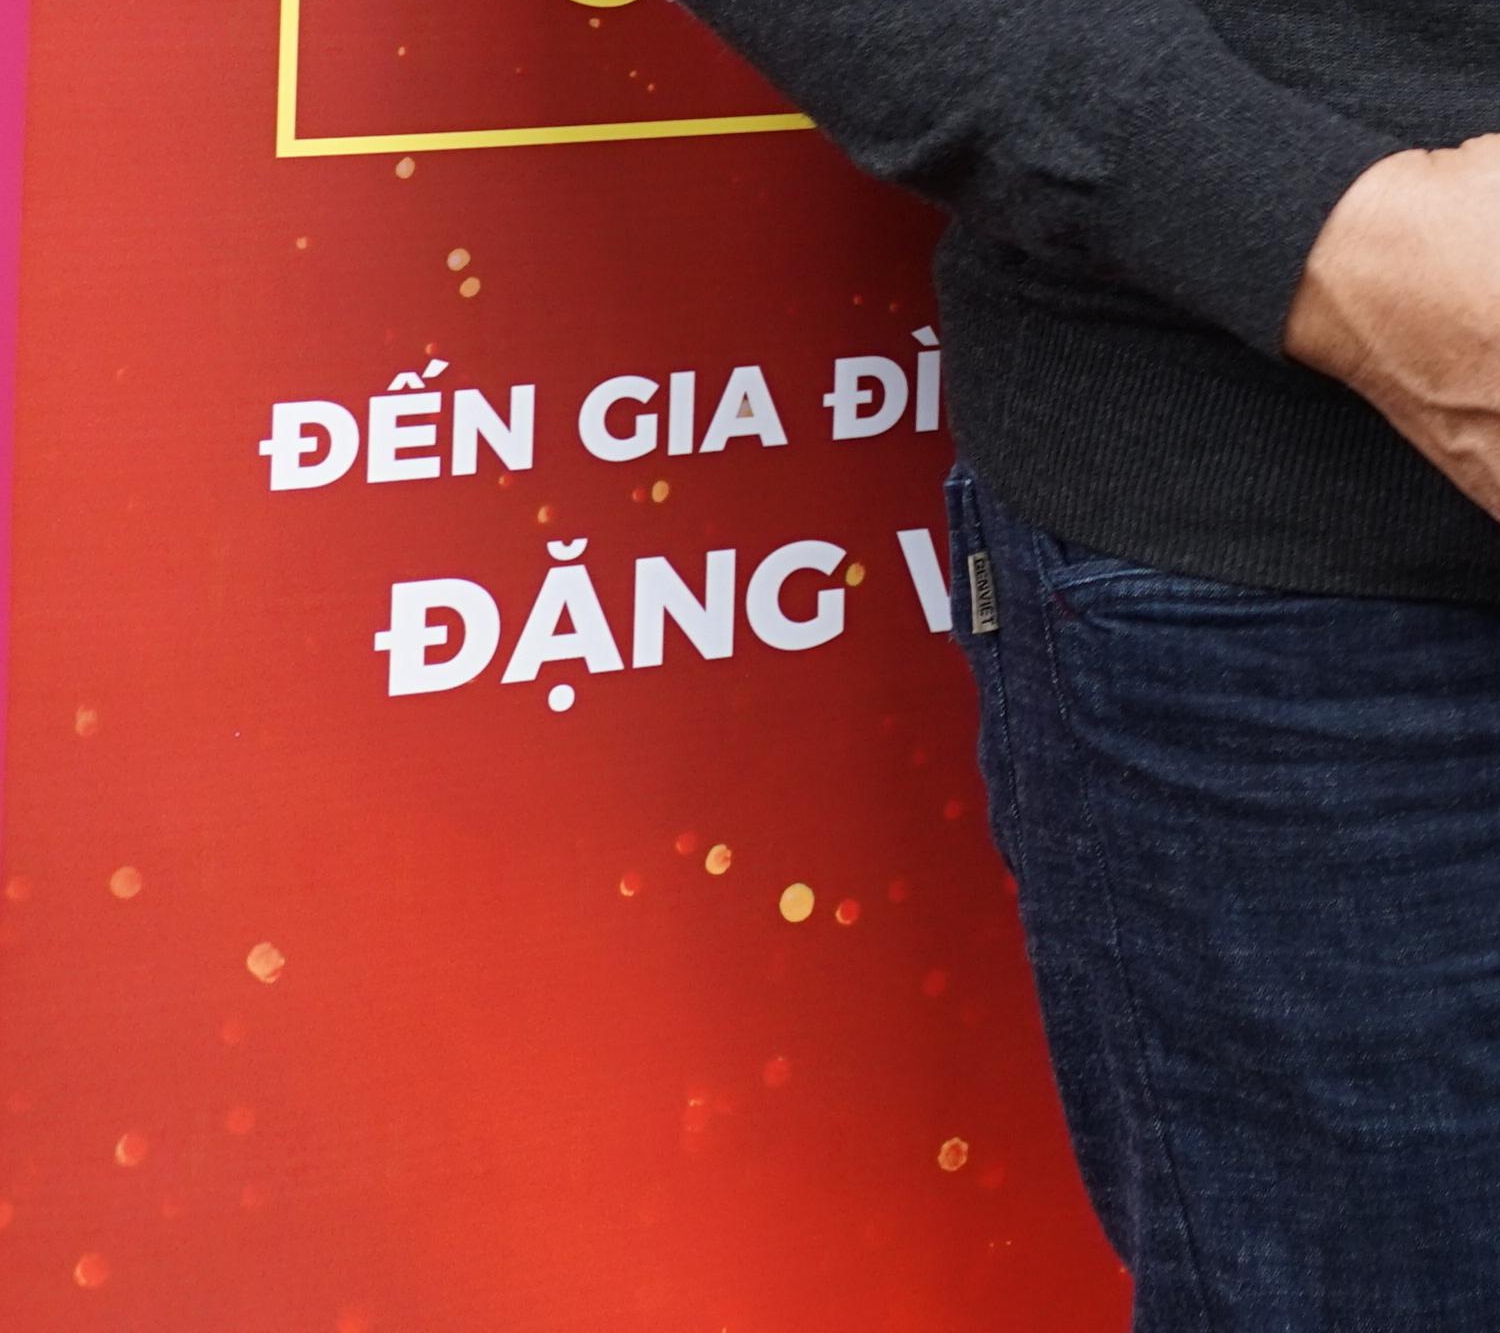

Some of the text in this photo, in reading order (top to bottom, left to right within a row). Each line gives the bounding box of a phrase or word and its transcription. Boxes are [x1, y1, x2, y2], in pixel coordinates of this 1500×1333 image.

[259, 359, 535, 491] ĐẾN
[578, 366, 787, 462] GIA
[374, 538, 846, 712] ĐẶNG
